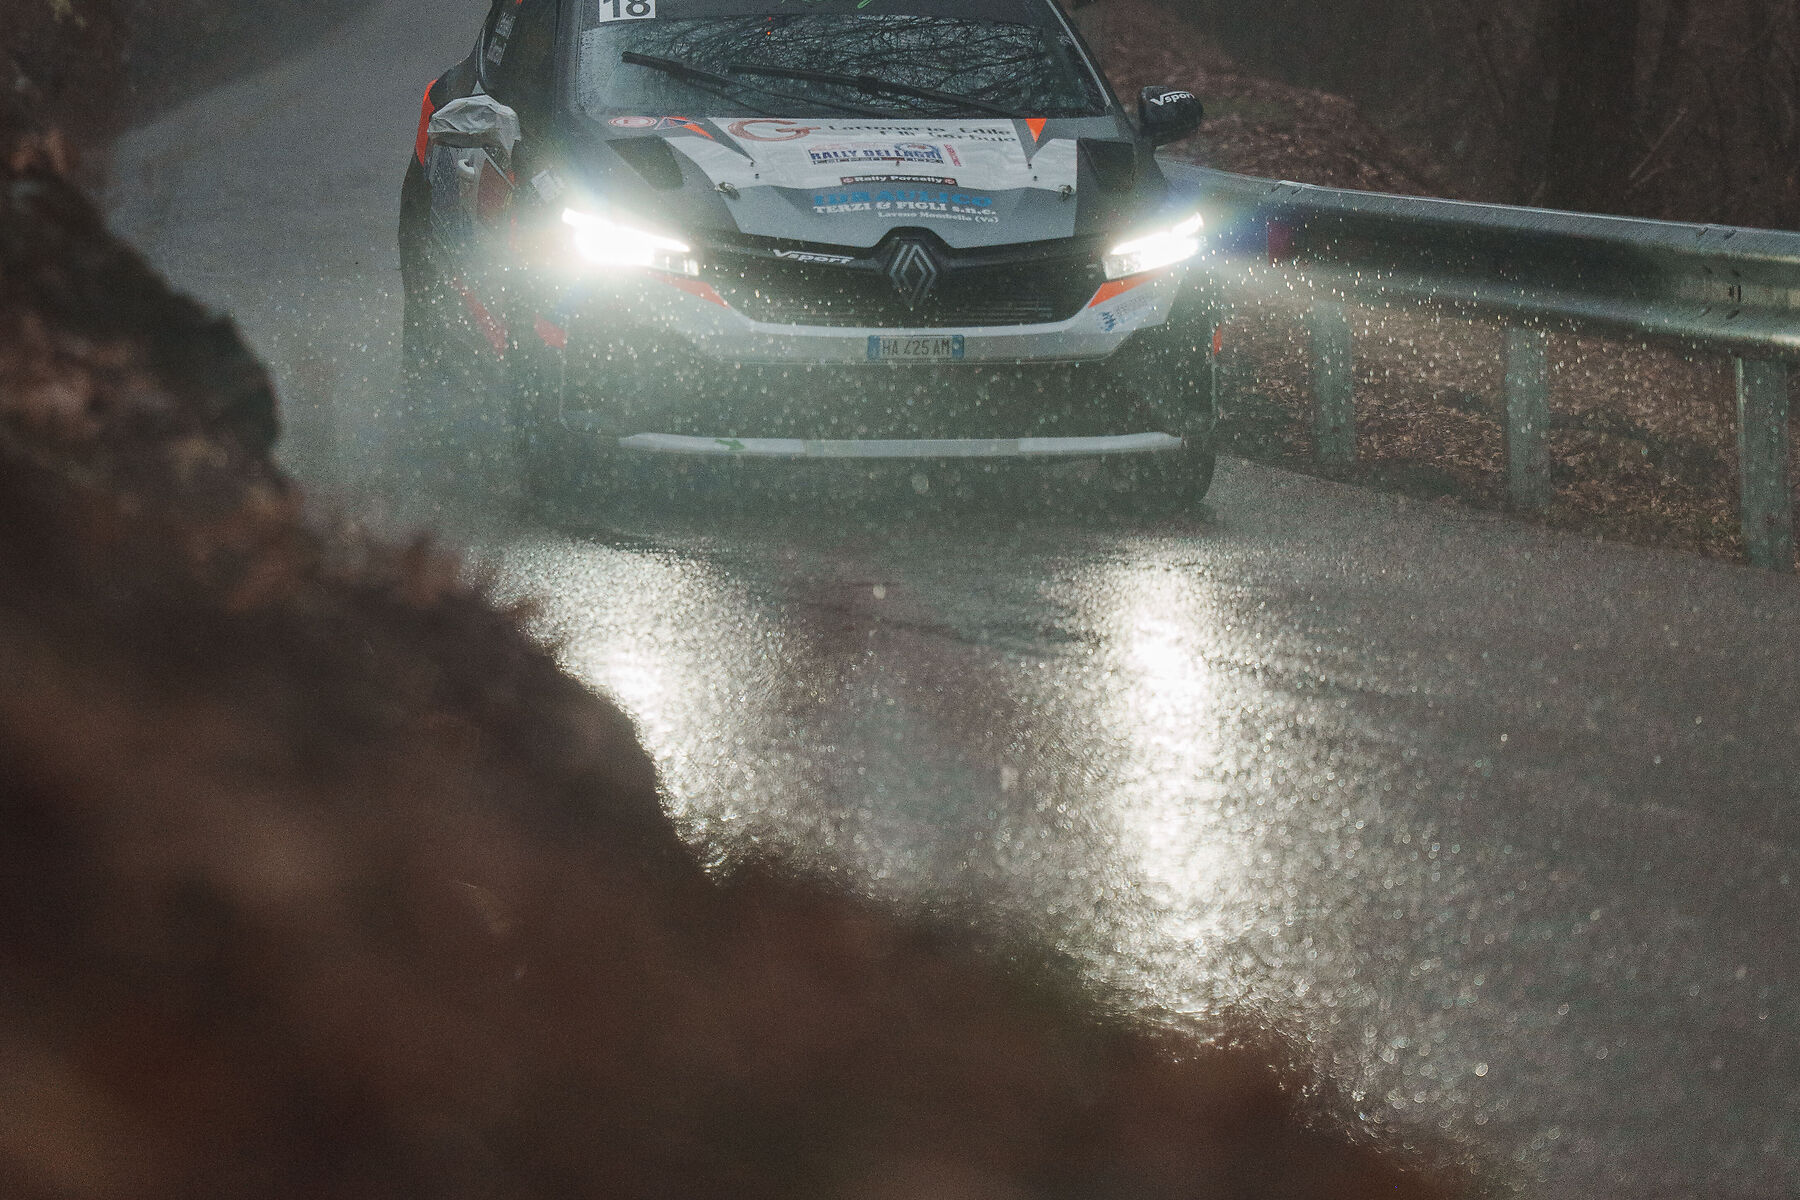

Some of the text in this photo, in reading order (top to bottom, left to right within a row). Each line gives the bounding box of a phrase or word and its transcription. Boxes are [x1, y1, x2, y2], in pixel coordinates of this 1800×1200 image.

[808, 150, 858, 161] RALLY
[895, 149, 945, 161] LAGHI
[854, 175, 887, 183] Rally
[813, 190, 993, 207] IDRAULICO
[813, 202, 872, 214] TERZI
[895, 201, 947, 212] FIGLI
